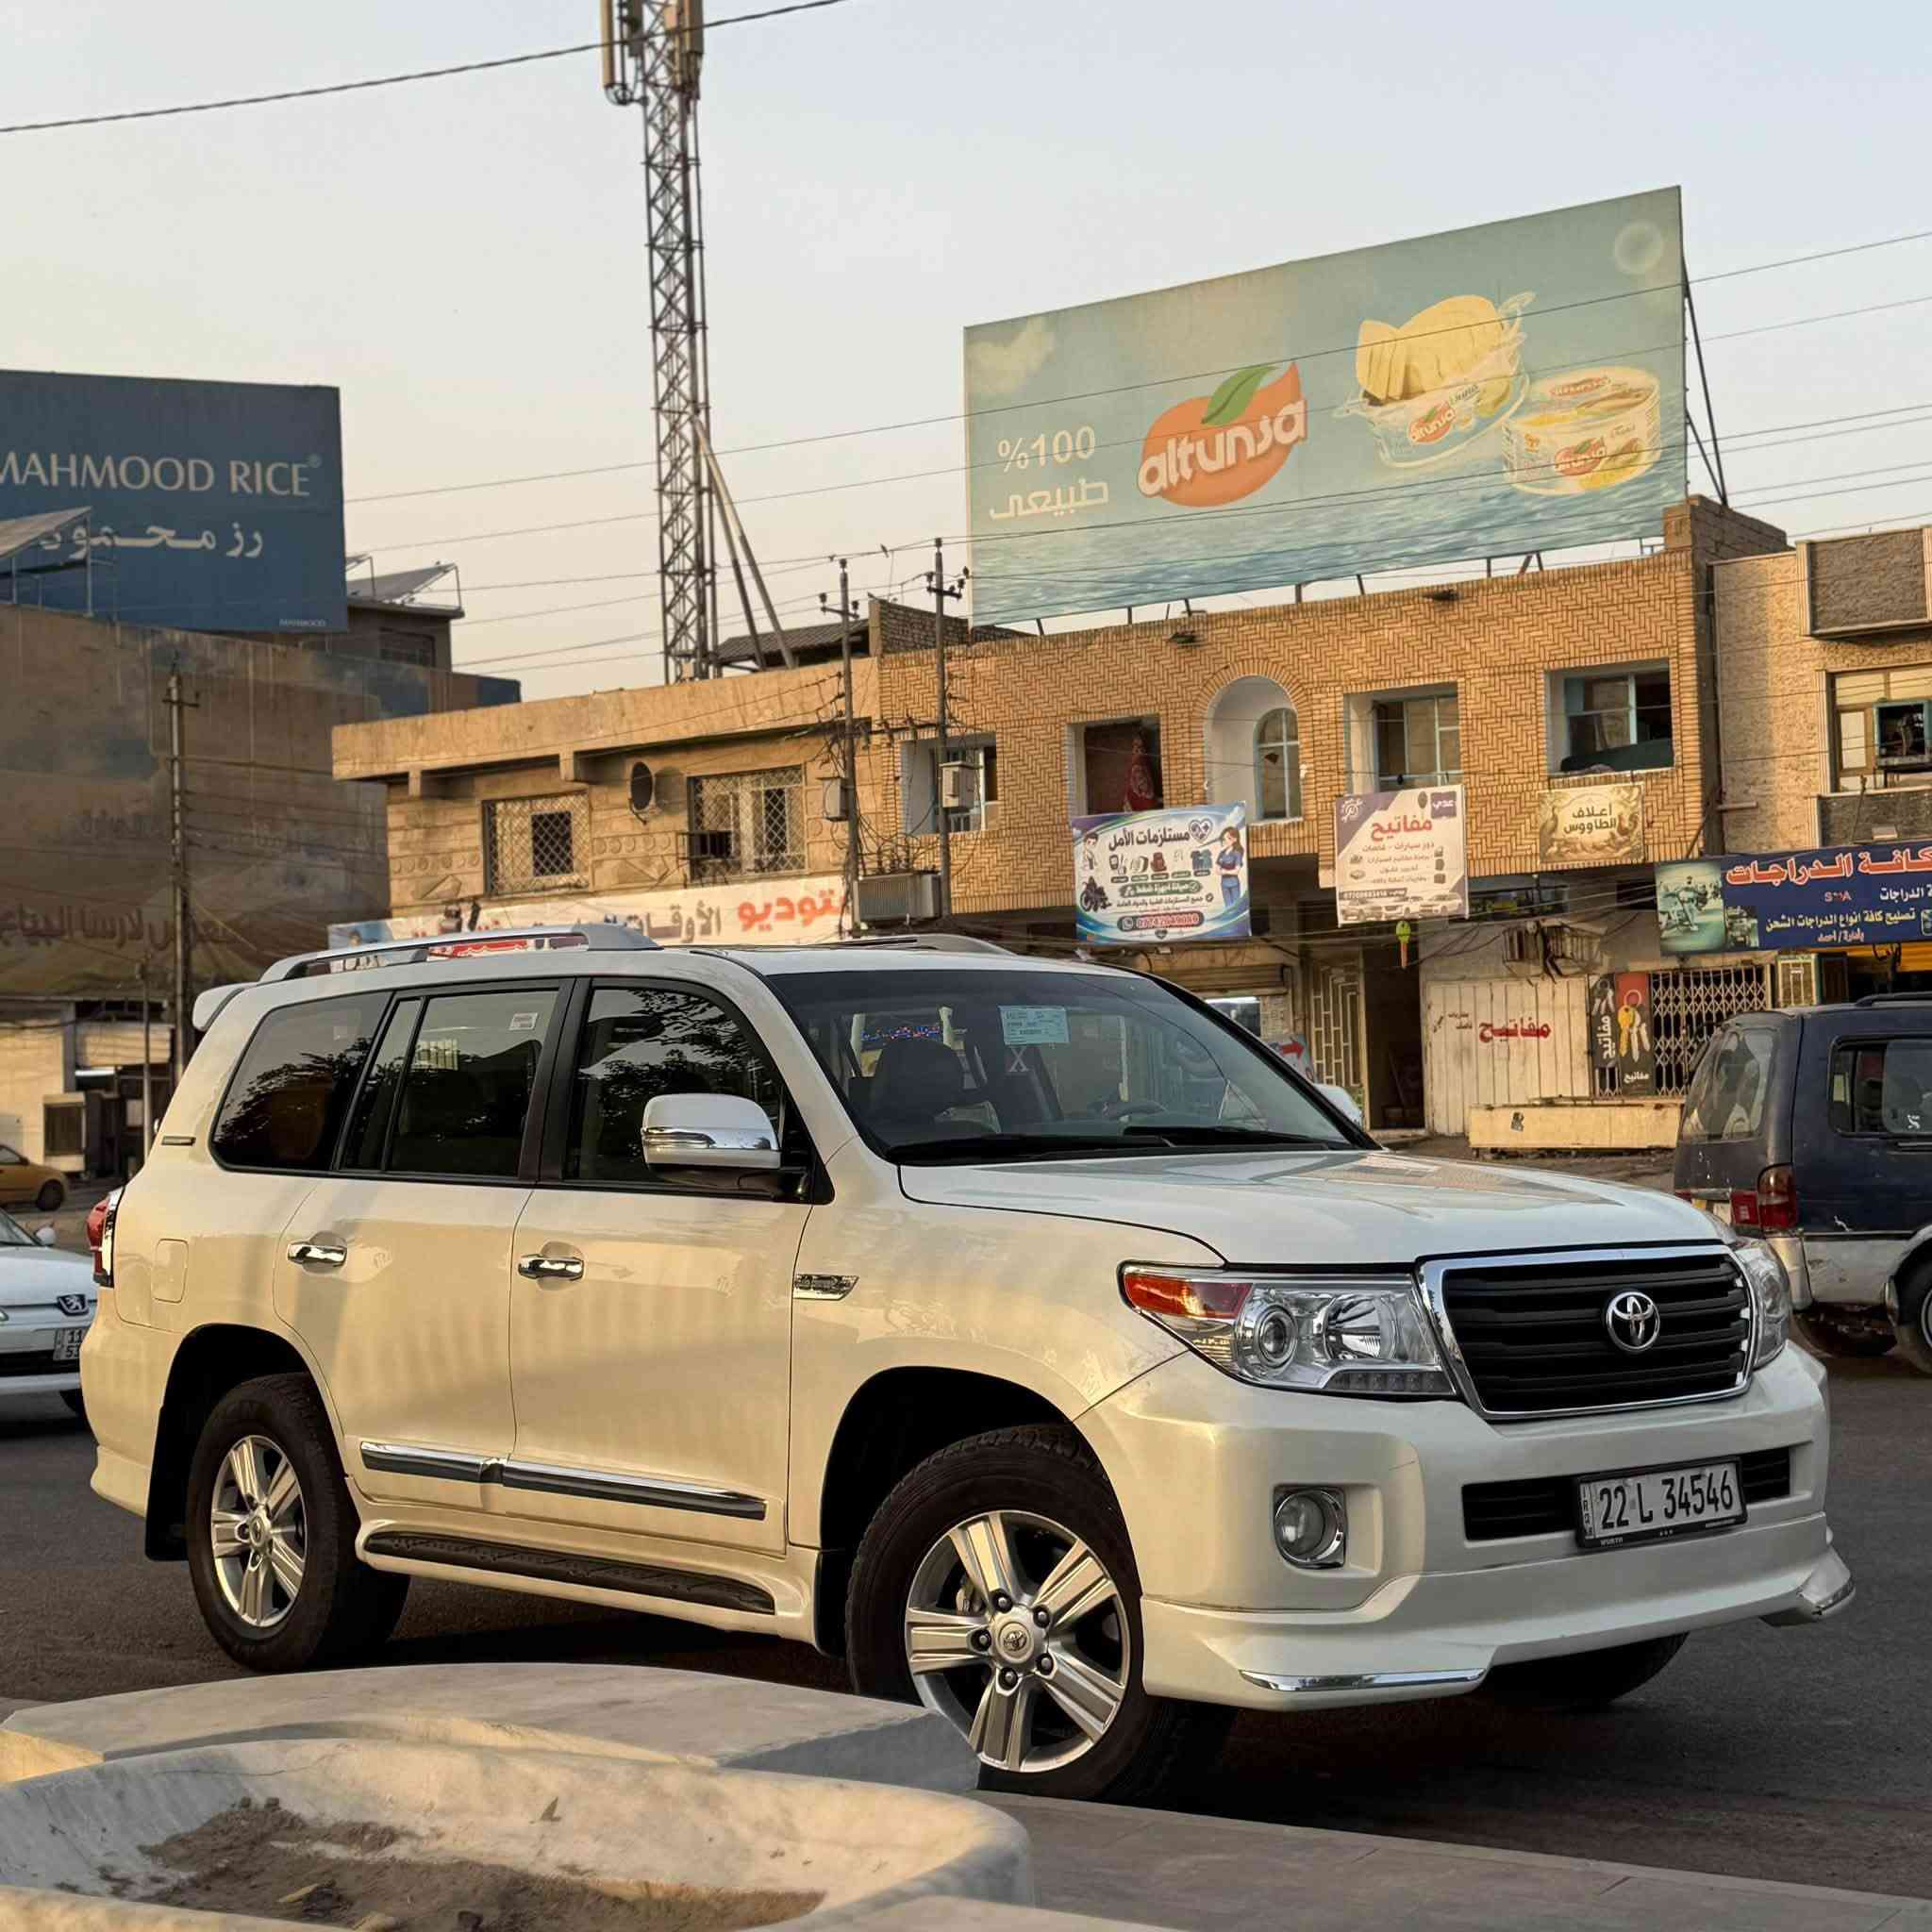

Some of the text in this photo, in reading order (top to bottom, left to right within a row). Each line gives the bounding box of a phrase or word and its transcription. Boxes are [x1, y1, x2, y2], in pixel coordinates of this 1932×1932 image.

[997, 425, 1095, 472] %100
[1138, 398, 1308, 496] altunsa
[226, 522, 263, 558] رز
[1108, 826, 1190, 851] مستلزمات الأمل
[1371, 814, 1433, 842] مفاتيح
[1563, 817, 1616, 835] الطاووس
[1726, 852, 1854, 887] الدراجات
[1879, 887, 1924, 903] الدراجات
[1478, 1016, 1552, 1043] مفاتيح
[1596, 1015, 1616, 1058] مفاتيح
[1599, 1470, 1734, 1529] 22 L 34546
